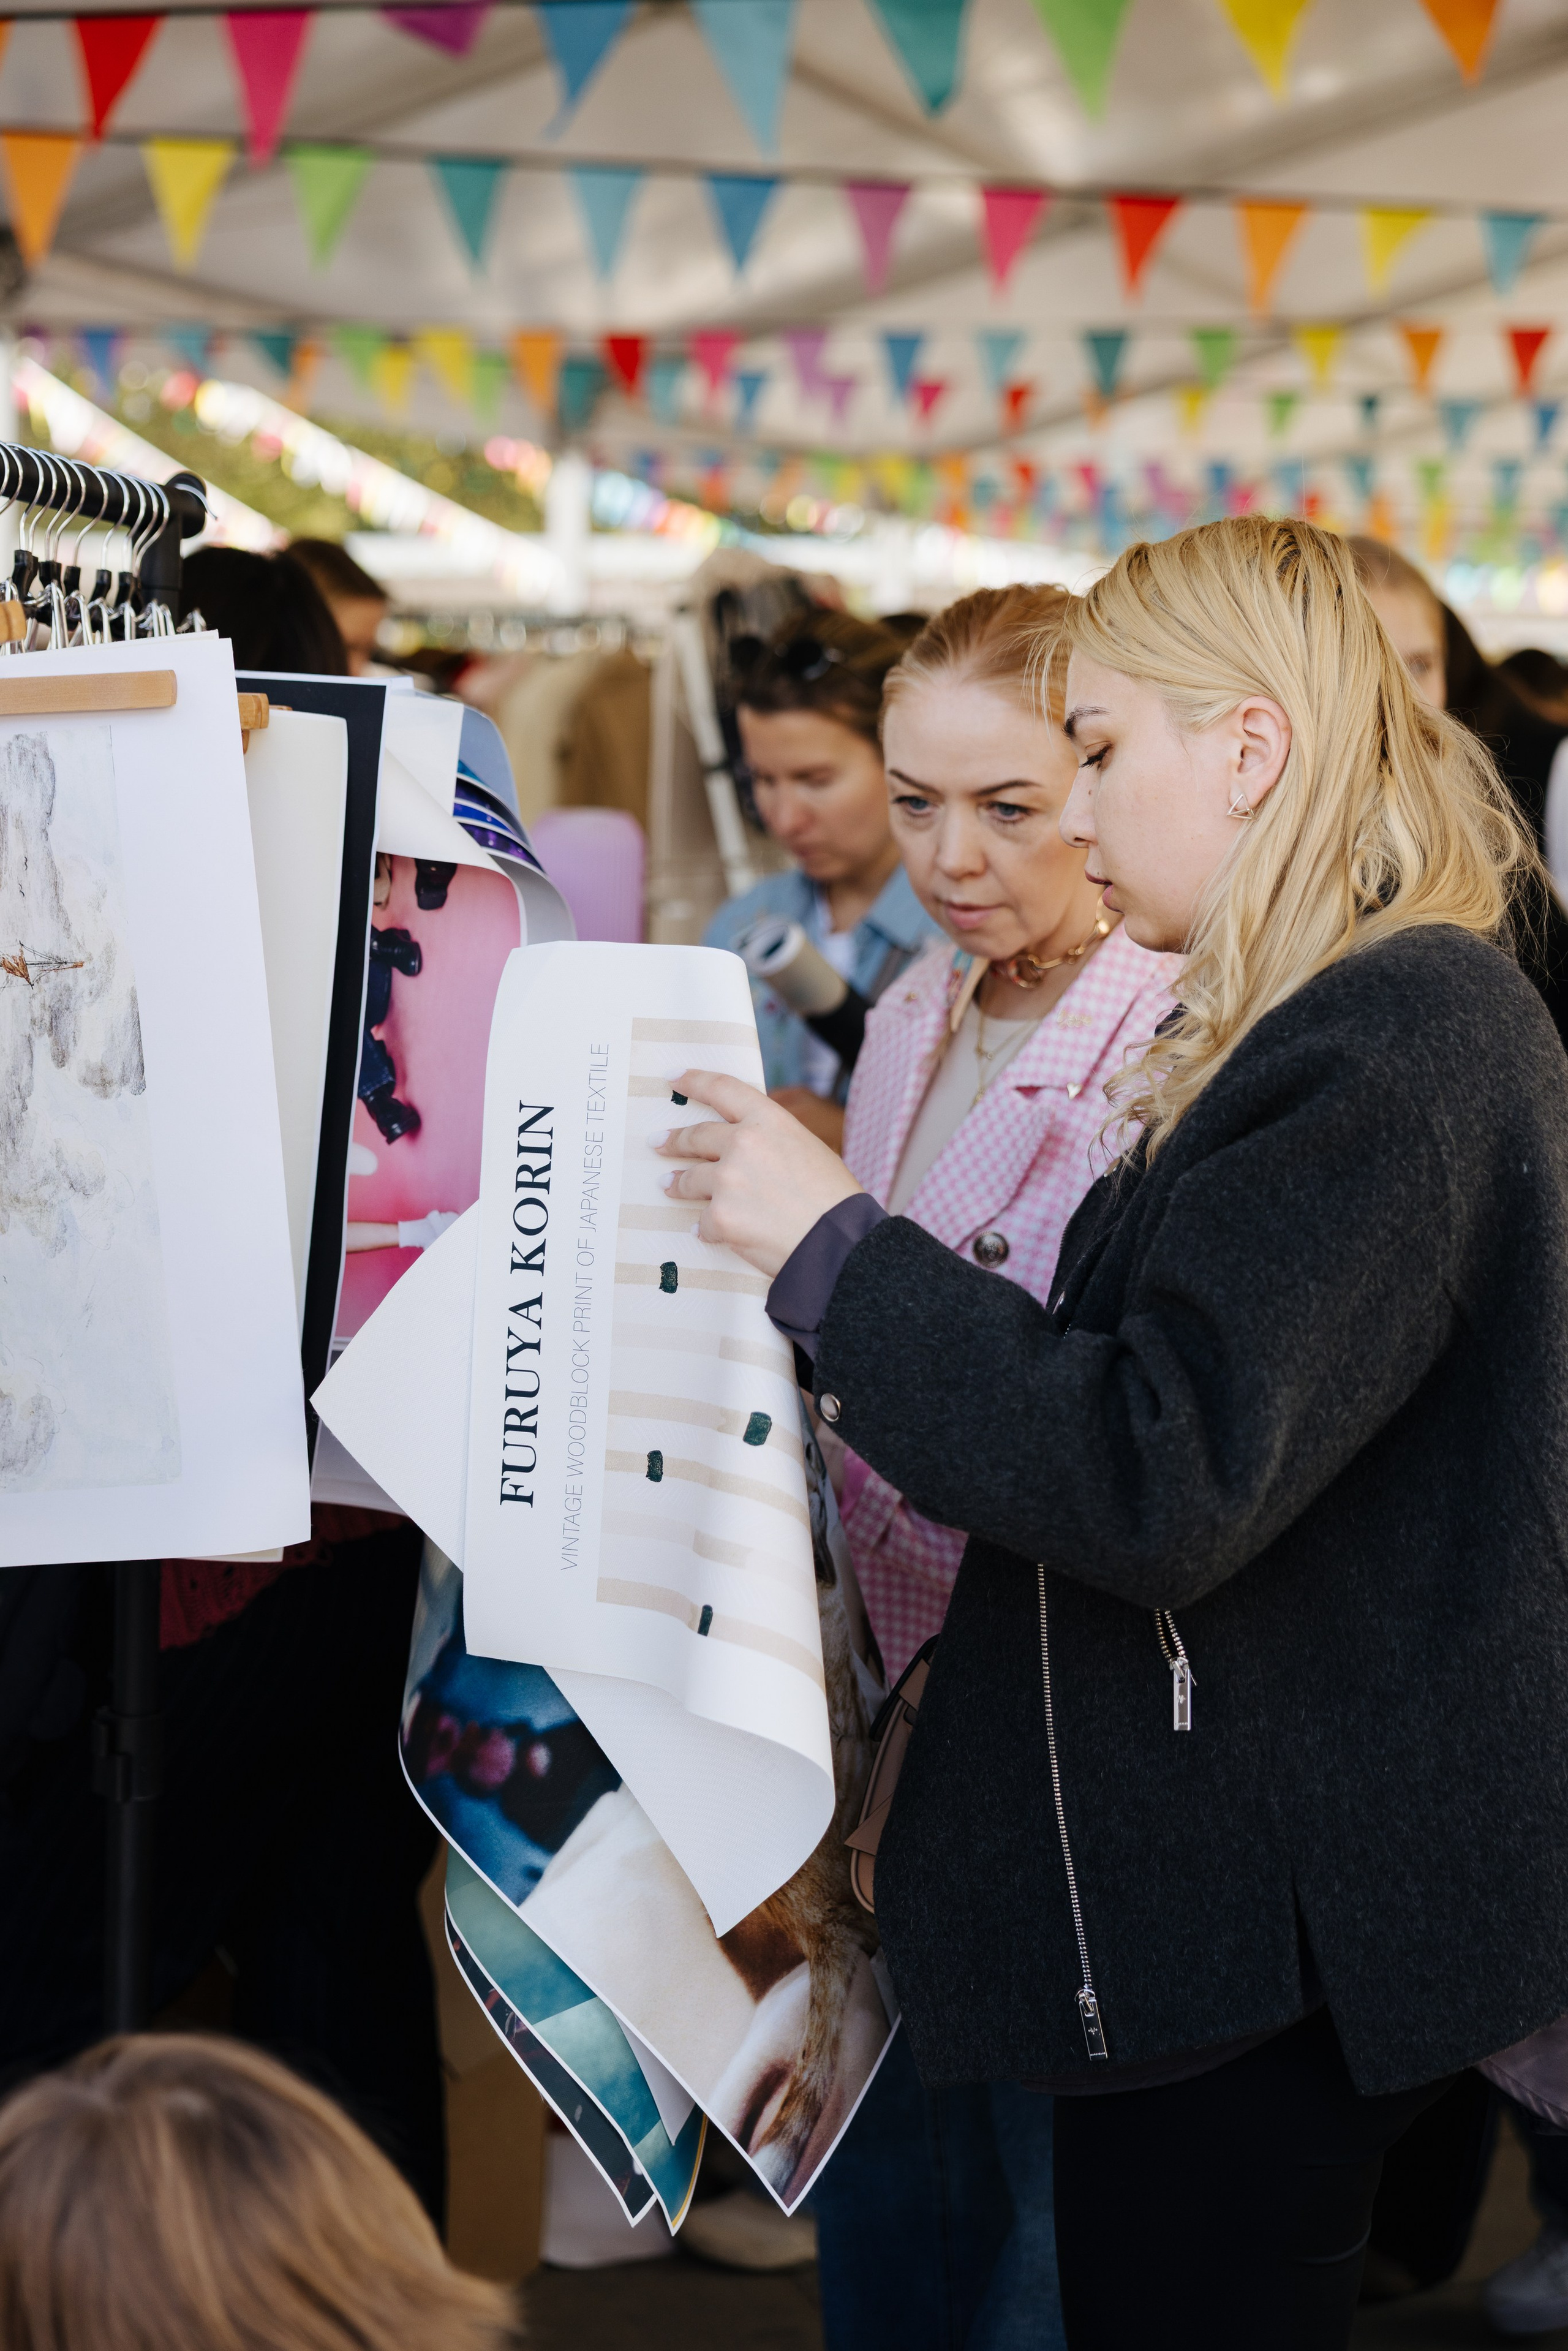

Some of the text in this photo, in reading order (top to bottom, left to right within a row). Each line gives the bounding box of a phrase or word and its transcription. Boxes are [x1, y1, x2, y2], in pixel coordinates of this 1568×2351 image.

[499, 1098, 555, 1509] FURUYA KORIN
[560, 1043, 609, 1571] VINTAGE WOODBLOCK PRINT OF JAPANESE TEXTILE
